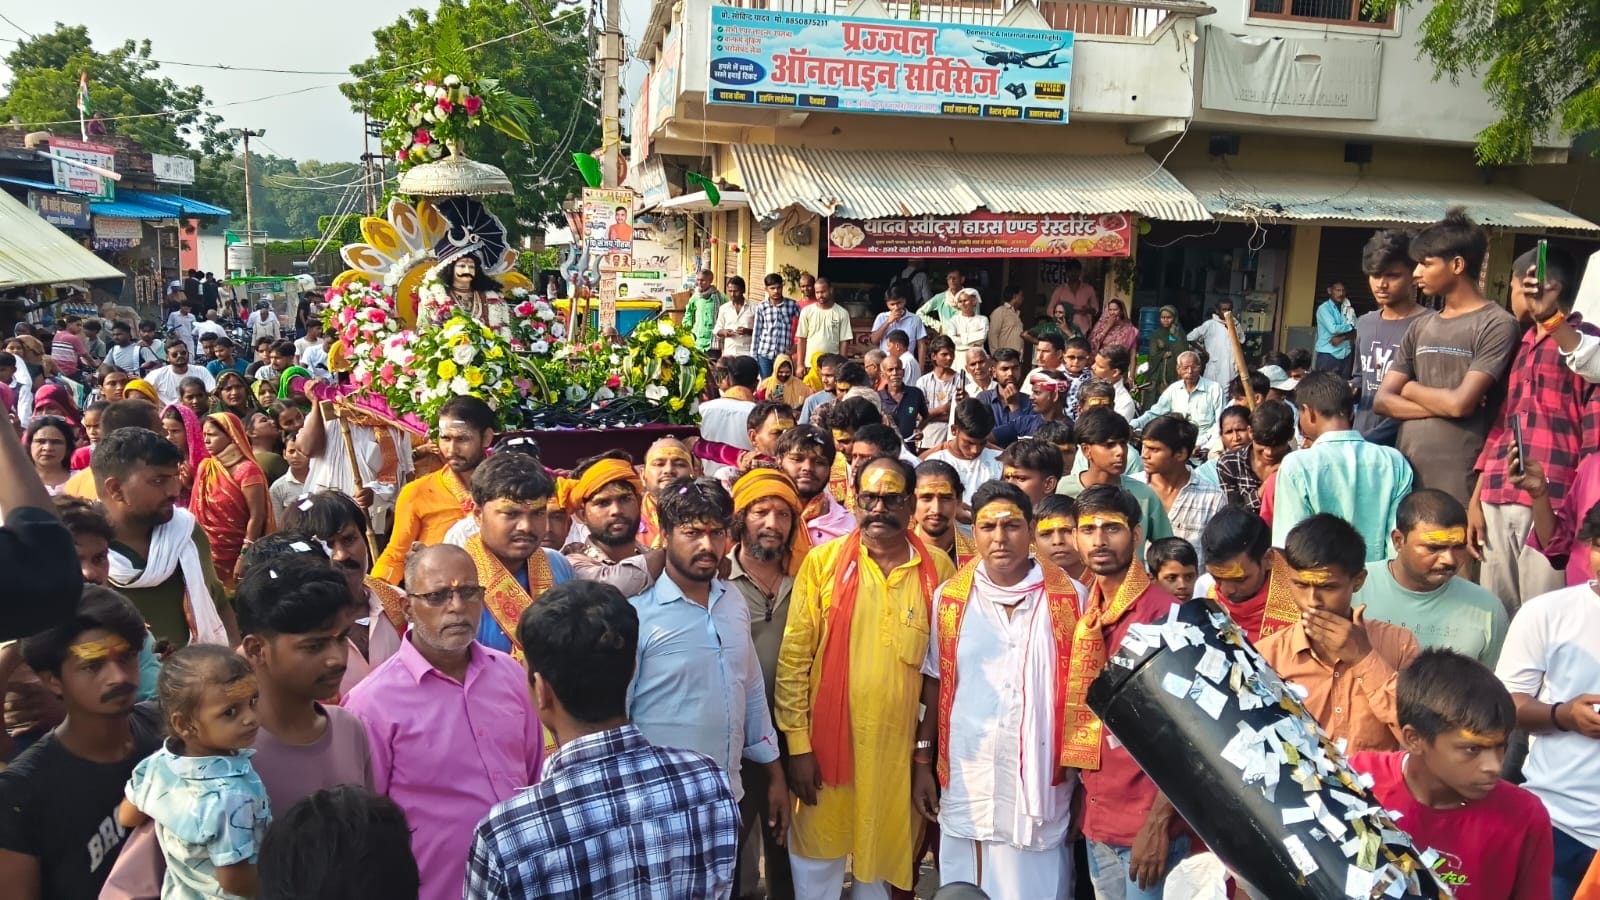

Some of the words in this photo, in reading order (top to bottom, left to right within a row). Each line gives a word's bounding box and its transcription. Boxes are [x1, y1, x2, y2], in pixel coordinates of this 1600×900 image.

[754, 14, 770, 22] यादव
[785, 17, 828, 27] 8850875211
[966, 29, 994, 37] Domestic
[1001, 31, 1040, 39] International
[1041, 34, 1062, 42] Flights
[727, 70, 742, 80] हवाई
[742, 71, 758, 81] टिकट
[771, 48, 898, 93] ऑनलाइन
[903, 57, 1002, 96] सर्विसेज
[864, 219, 907, 234] यादव
[908, 215, 960, 240] स्वीट्स
[962, 220, 1004, 234] हाउस
[1005, 220, 1038, 234] एण्ड
[1040, 214, 1096, 235] रेस्टोरेंट
[911, 245, 923, 253] देशी
